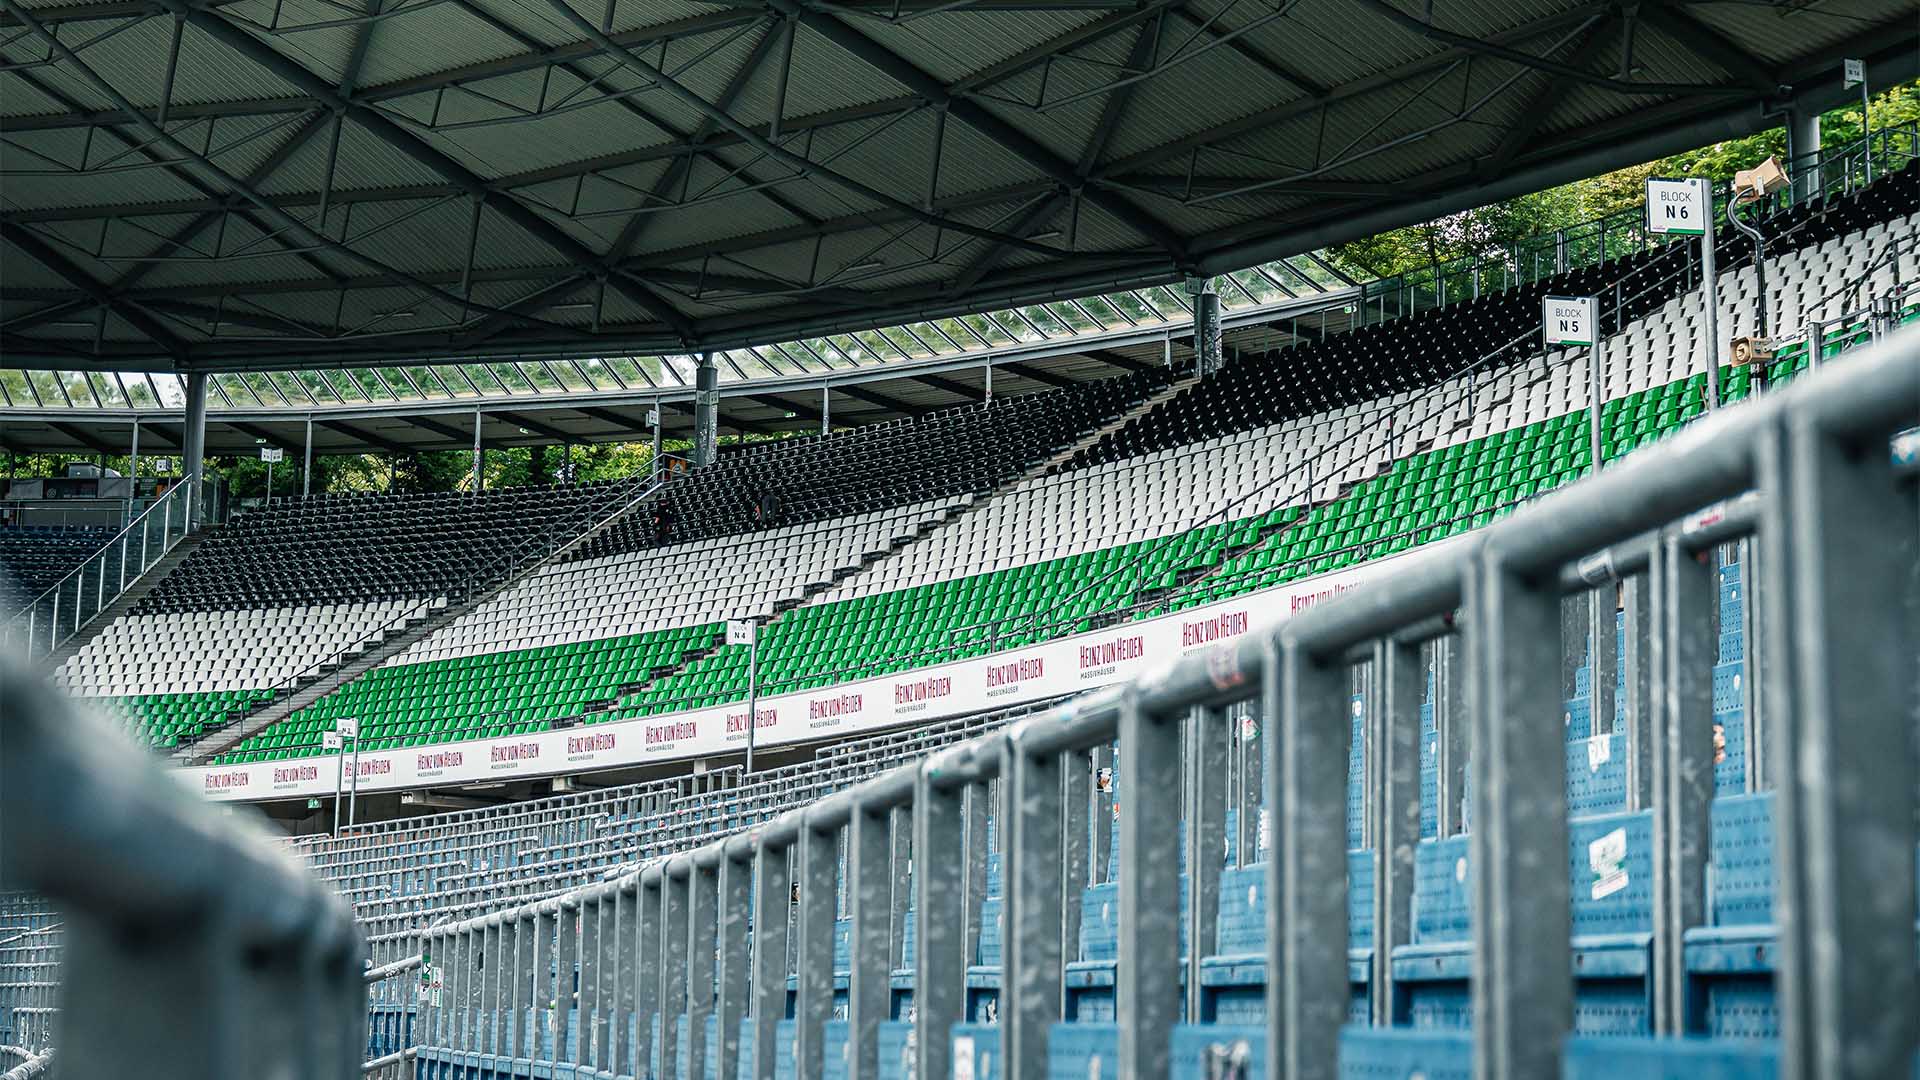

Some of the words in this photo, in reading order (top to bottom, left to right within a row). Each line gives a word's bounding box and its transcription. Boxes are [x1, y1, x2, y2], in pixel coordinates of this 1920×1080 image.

[1660, 191, 1692, 202] BLOCK
[1666, 205, 1676, 219] N
[1680, 206, 1689, 219] 6
[1555, 308, 1582, 318] BLOCK
[1560, 320, 1568, 332] N
[1572, 321, 1580, 333] 5
[734, 631, 740, 639] N
[1183, 622, 1204, 647] HEINZ
[1205, 617, 1220, 642] VON
[1220, 611, 1248, 639] HEIDEN
[1080, 645, 1101, 669] HEINZ
[1102, 642, 1116, 665] VON
[1117, 636, 1144, 661] HEIDEN
[987, 666, 1005, 688] HEINZ
[1006, 663, 1019, 684] VON
[1020, 658, 1043, 681] HEIDEN
[1080, 666, 1116, 680] MASSIVHÄUSER
[895, 683, 914, 705] HEINZ
[914, 681, 927, 701] VON
[928, 677, 951, 699] HEIDEN
[810, 700, 828, 720] HEINZ
[829, 698, 841, 717] VON
[841, 694, 863, 715] HEIDEN
[727, 714, 743, 733] HEINZ
[756, 709, 777, 729] HEIDEN
[646, 725, 663, 744] HEINZ
[664, 725, 676, 741] VON
[675, 722, 697, 741] HEIDEN
[491, 745, 508, 762] HEINZ
[508, 745, 519, 760] VON
[519, 743, 540, 760] HEIDEN
[568, 736, 584, 754] HEINZ
[584, 736, 596, 752] VON
[596, 733, 616, 751] HEIDEN
[371, 759, 391, 775] HEIDEN
[418, 754, 433, 770] HEINZ
[444, 751, 463, 768] HEIDEN
[274, 768, 289, 783] HEINZ
[300, 766, 318, 781] HEIDEN
